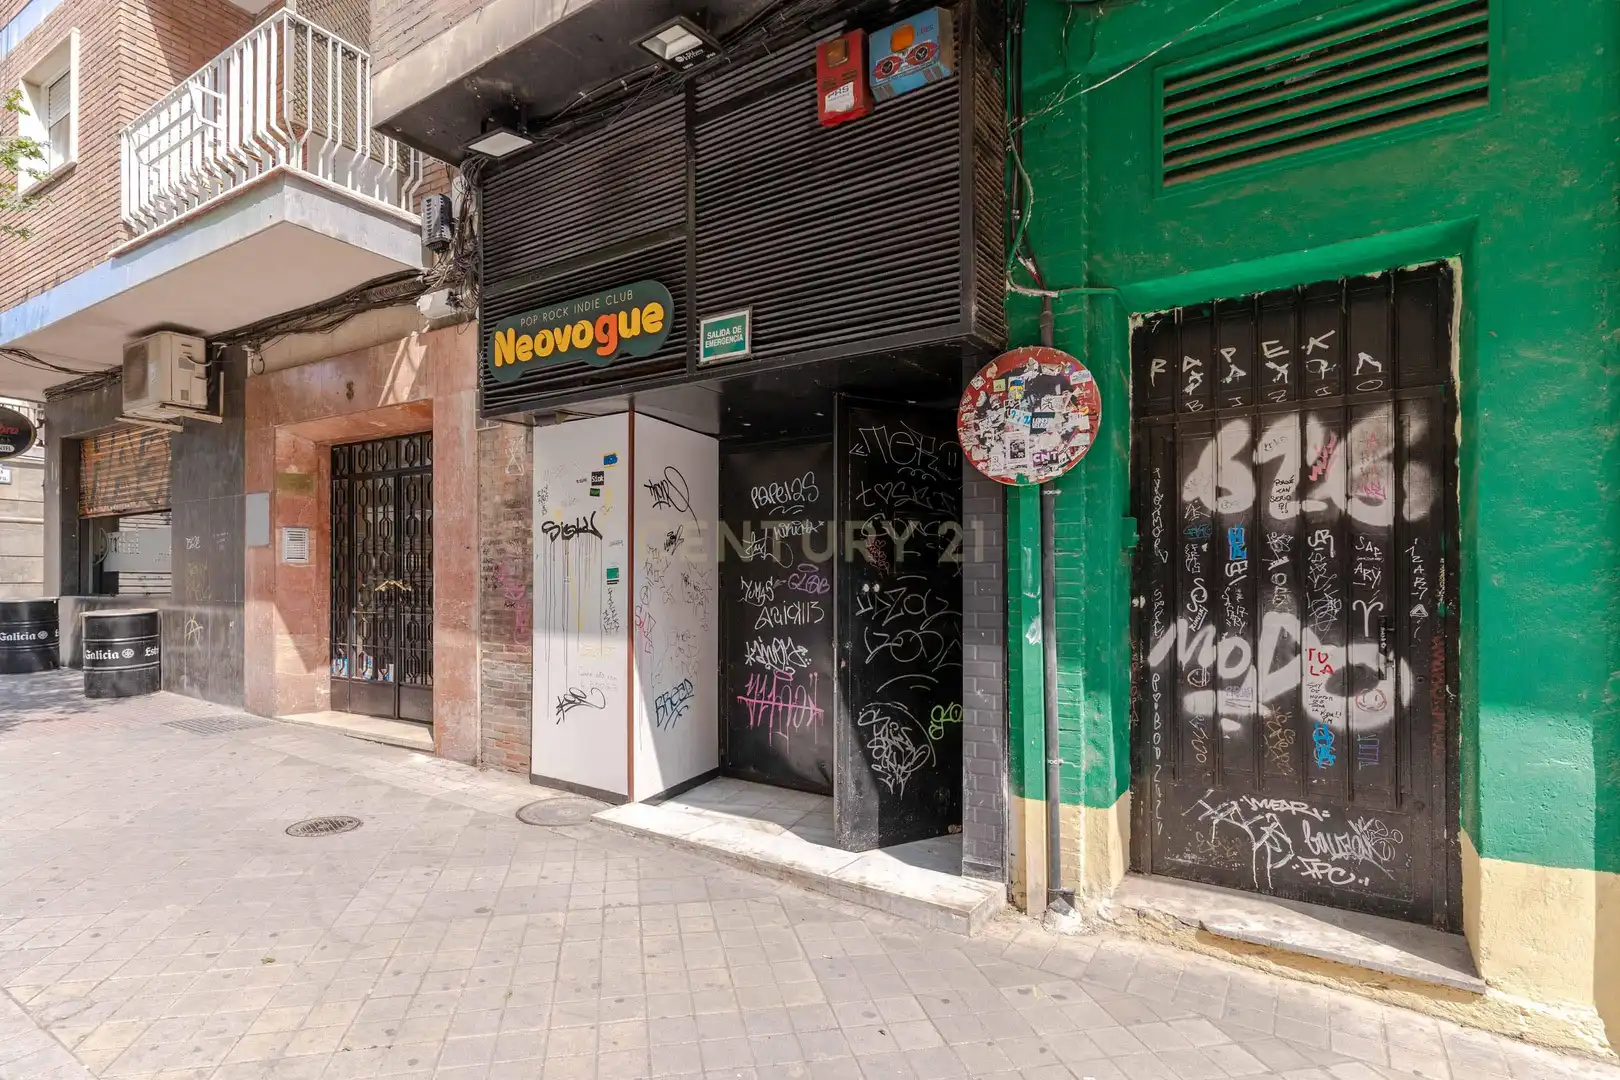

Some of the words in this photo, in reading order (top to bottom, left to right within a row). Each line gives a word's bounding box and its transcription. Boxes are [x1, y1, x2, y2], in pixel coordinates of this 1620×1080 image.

[520, 314, 539, 327] POP
[542, 307, 569, 321] ROCK
[573, 298, 601, 313] INDIE
[605, 289, 633, 305] CLUB
[494, 302, 665, 367] Neovogue
[706, 328, 730, 340] SALIDA
[732, 325, 742, 334] DE
[705, 334, 744, 349] EMERGENCIA
[0, 631, 36, 642] Galicia
[85, 649, 119, 660] Galicia
